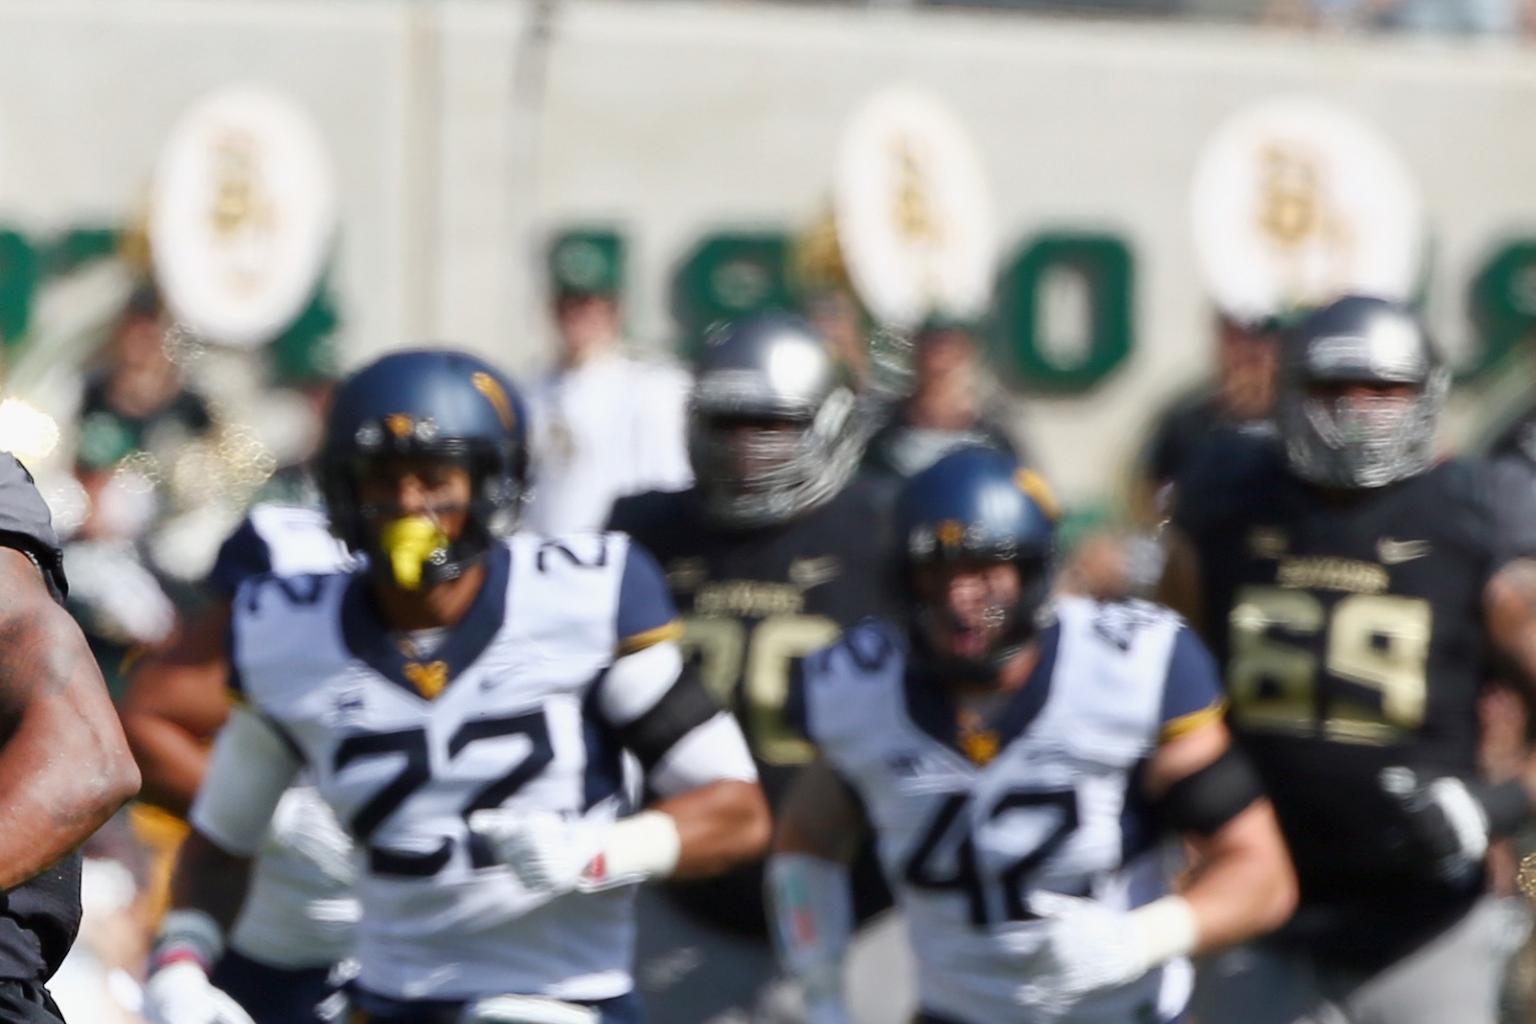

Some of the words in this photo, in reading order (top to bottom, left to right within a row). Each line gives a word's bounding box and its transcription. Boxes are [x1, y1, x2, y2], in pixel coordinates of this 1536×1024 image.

[1229, 585, 1432, 748] 69
[332, 706, 556, 880] 22
[904, 788, 1094, 928] 42
